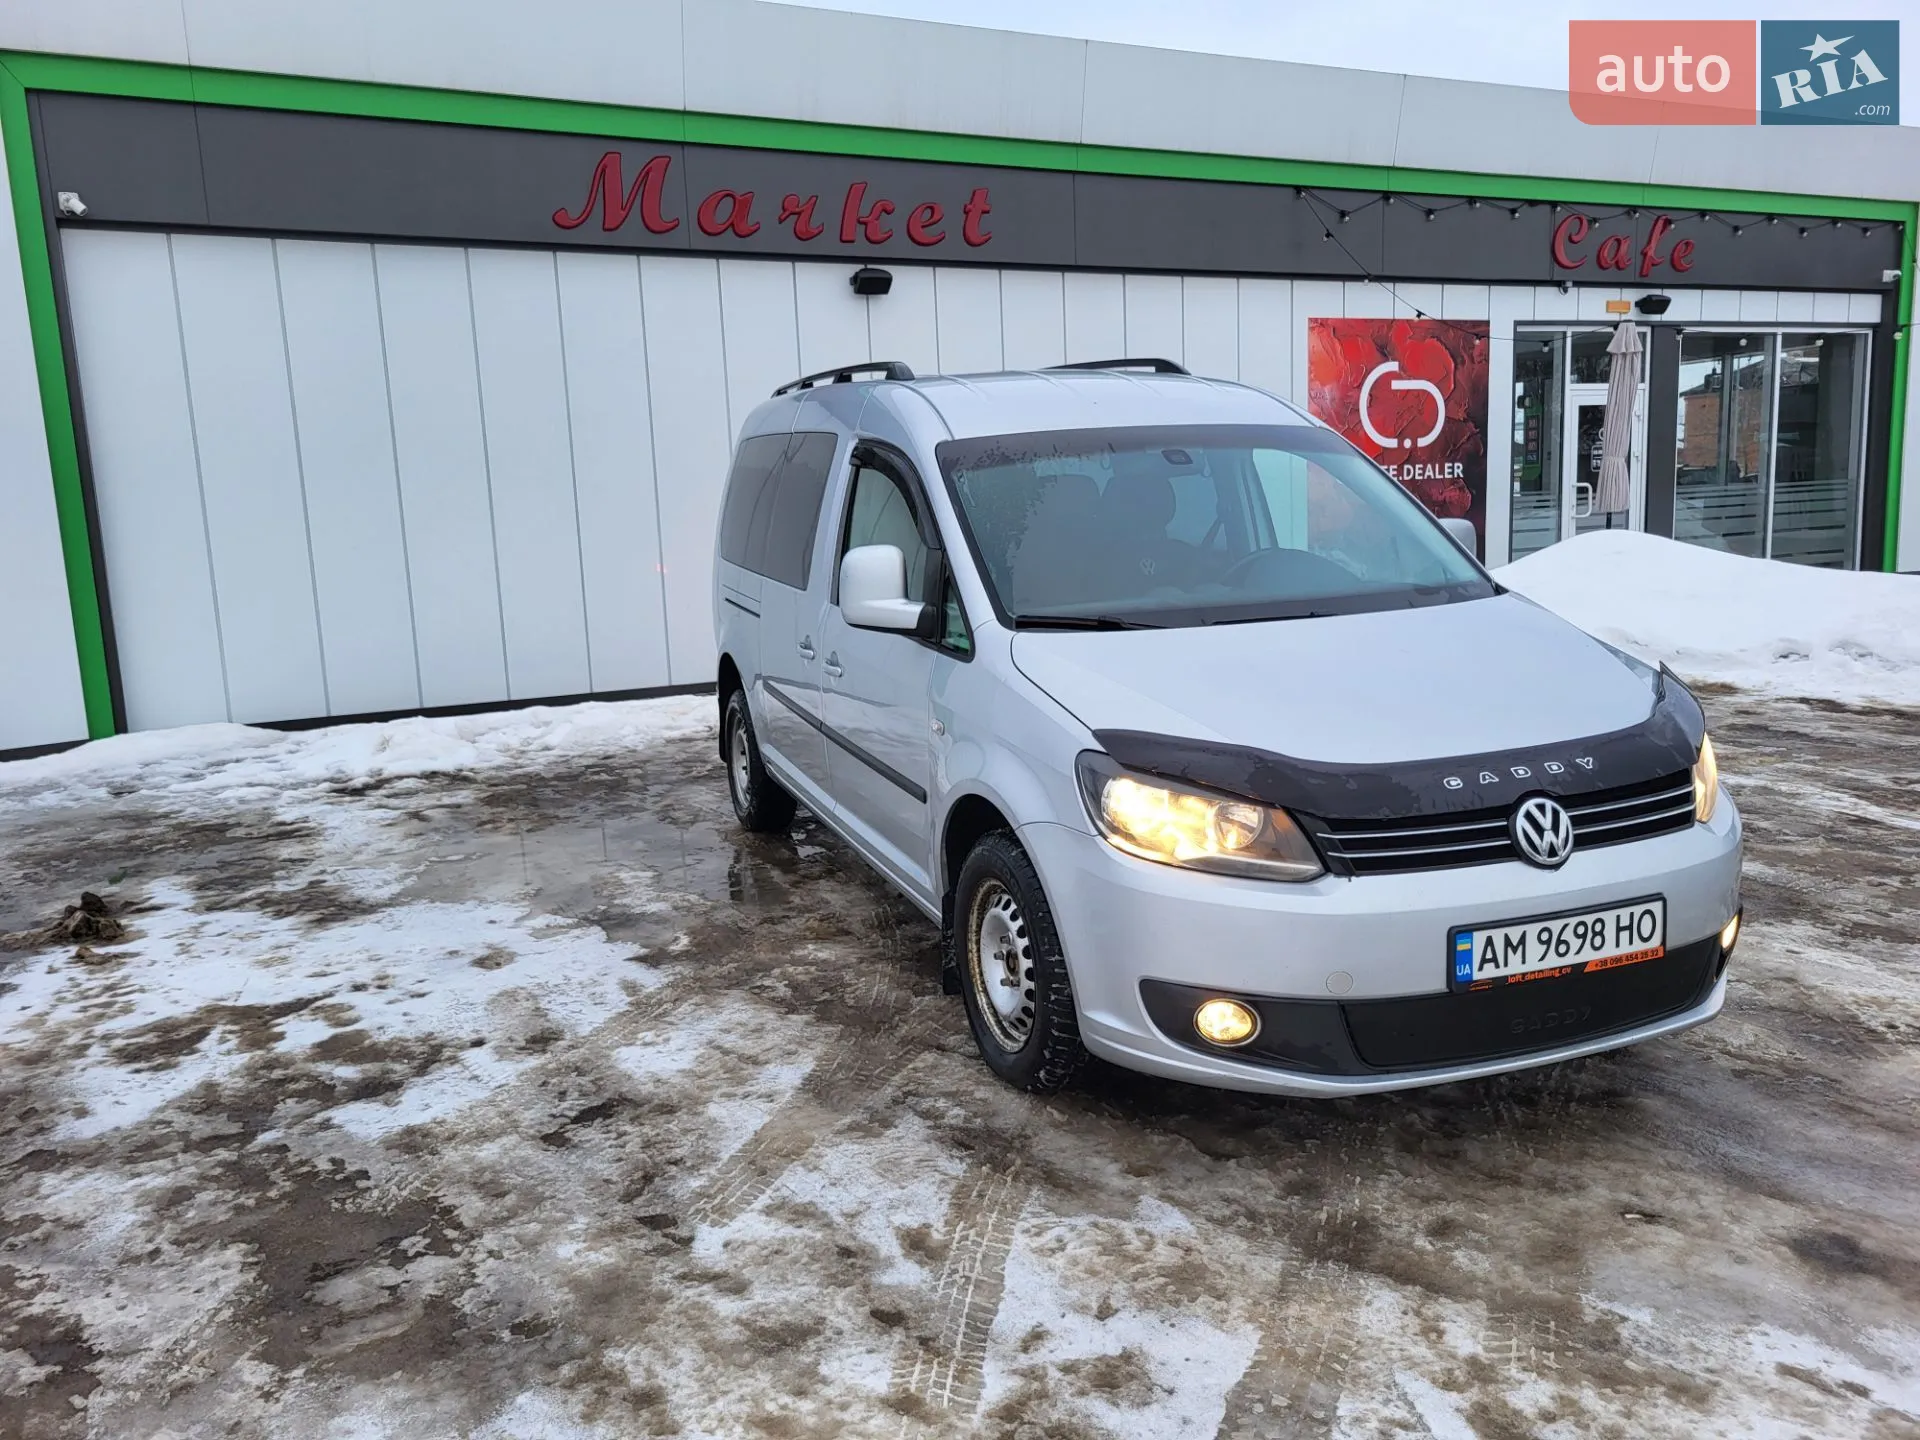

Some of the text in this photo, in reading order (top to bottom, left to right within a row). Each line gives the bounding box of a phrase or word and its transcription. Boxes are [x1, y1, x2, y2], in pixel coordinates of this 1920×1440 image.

[552, 151, 993, 247] Market
[1552, 213, 1696, 278] Cafe
[1380, 462, 1464, 480] E.DEALER
[1443, 757, 1594, 789] CADDY
[1477, 908, 1658, 973] AM 9698 HO
[1456, 963, 1471, 977] UA
